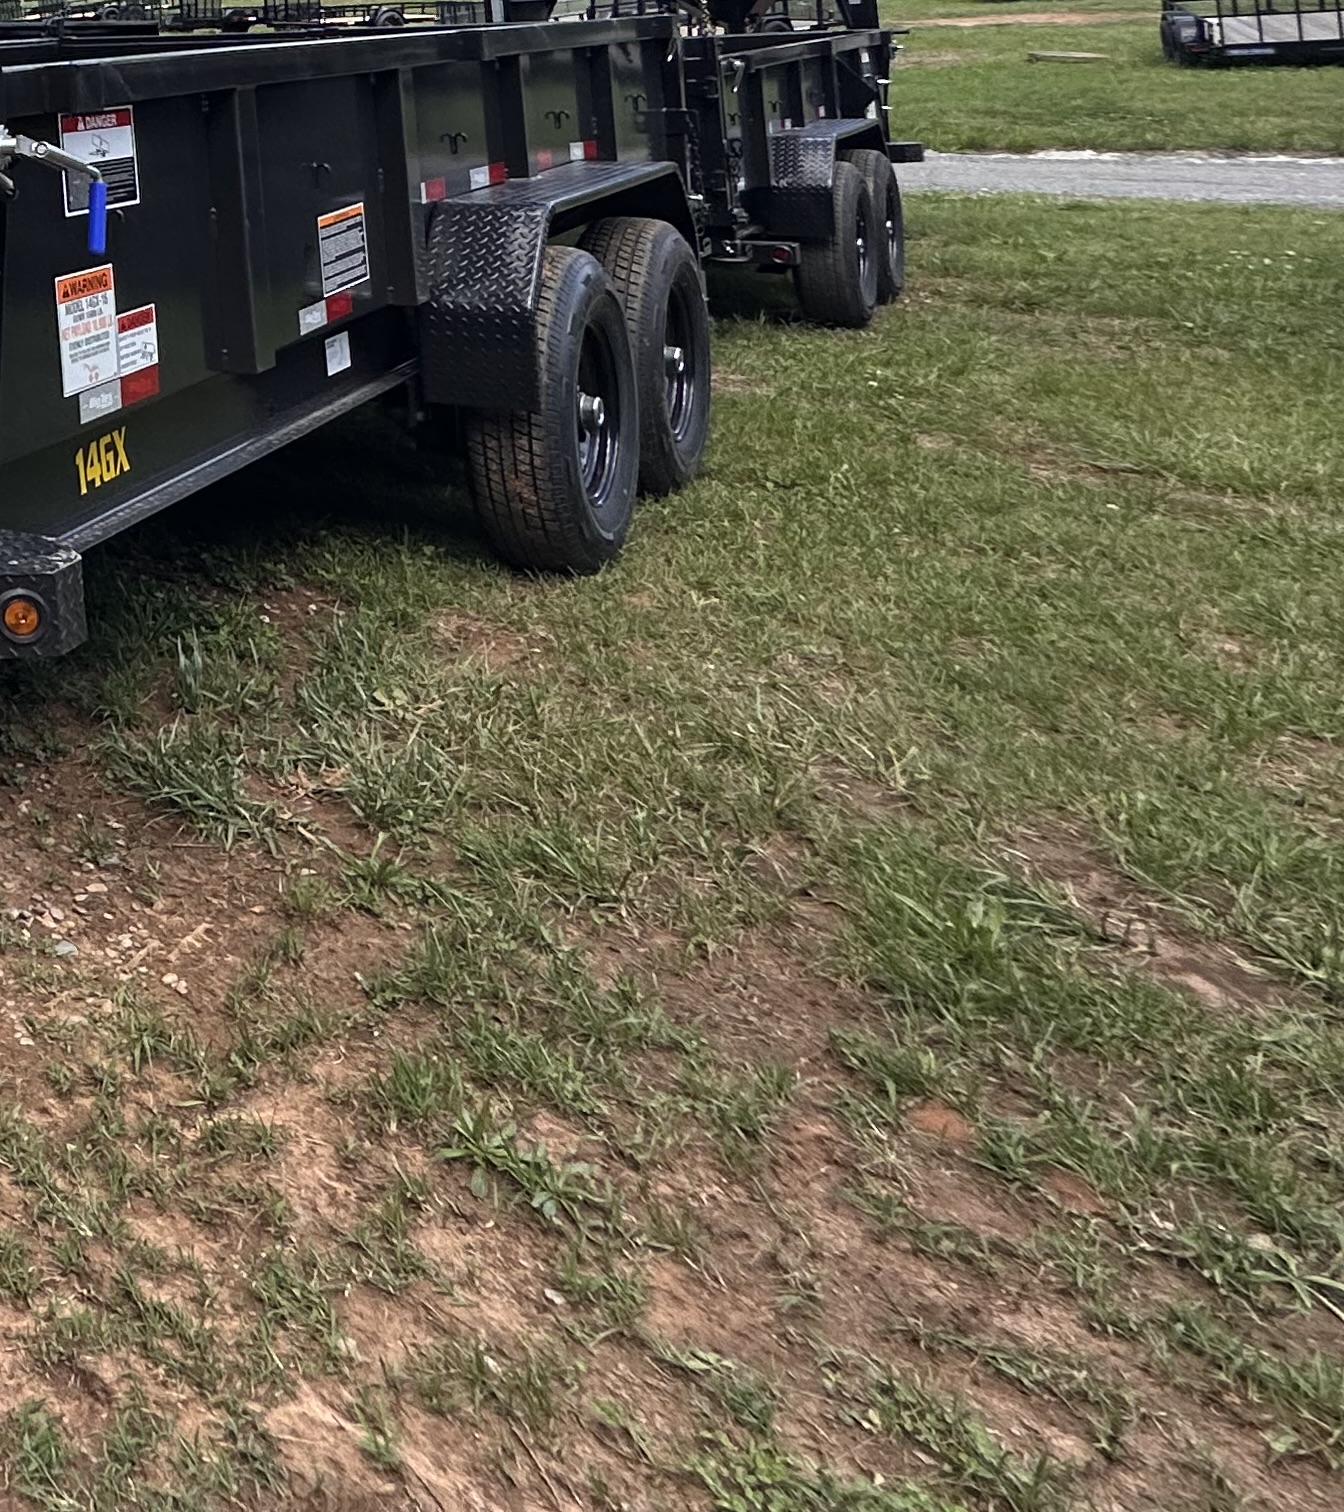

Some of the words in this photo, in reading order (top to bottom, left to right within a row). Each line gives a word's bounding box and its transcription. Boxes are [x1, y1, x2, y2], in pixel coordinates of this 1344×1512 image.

[85, 113, 118, 130] DANGER
[69, 272, 108, 296] WARNING
[75, 426, 131, 496] 14GX
